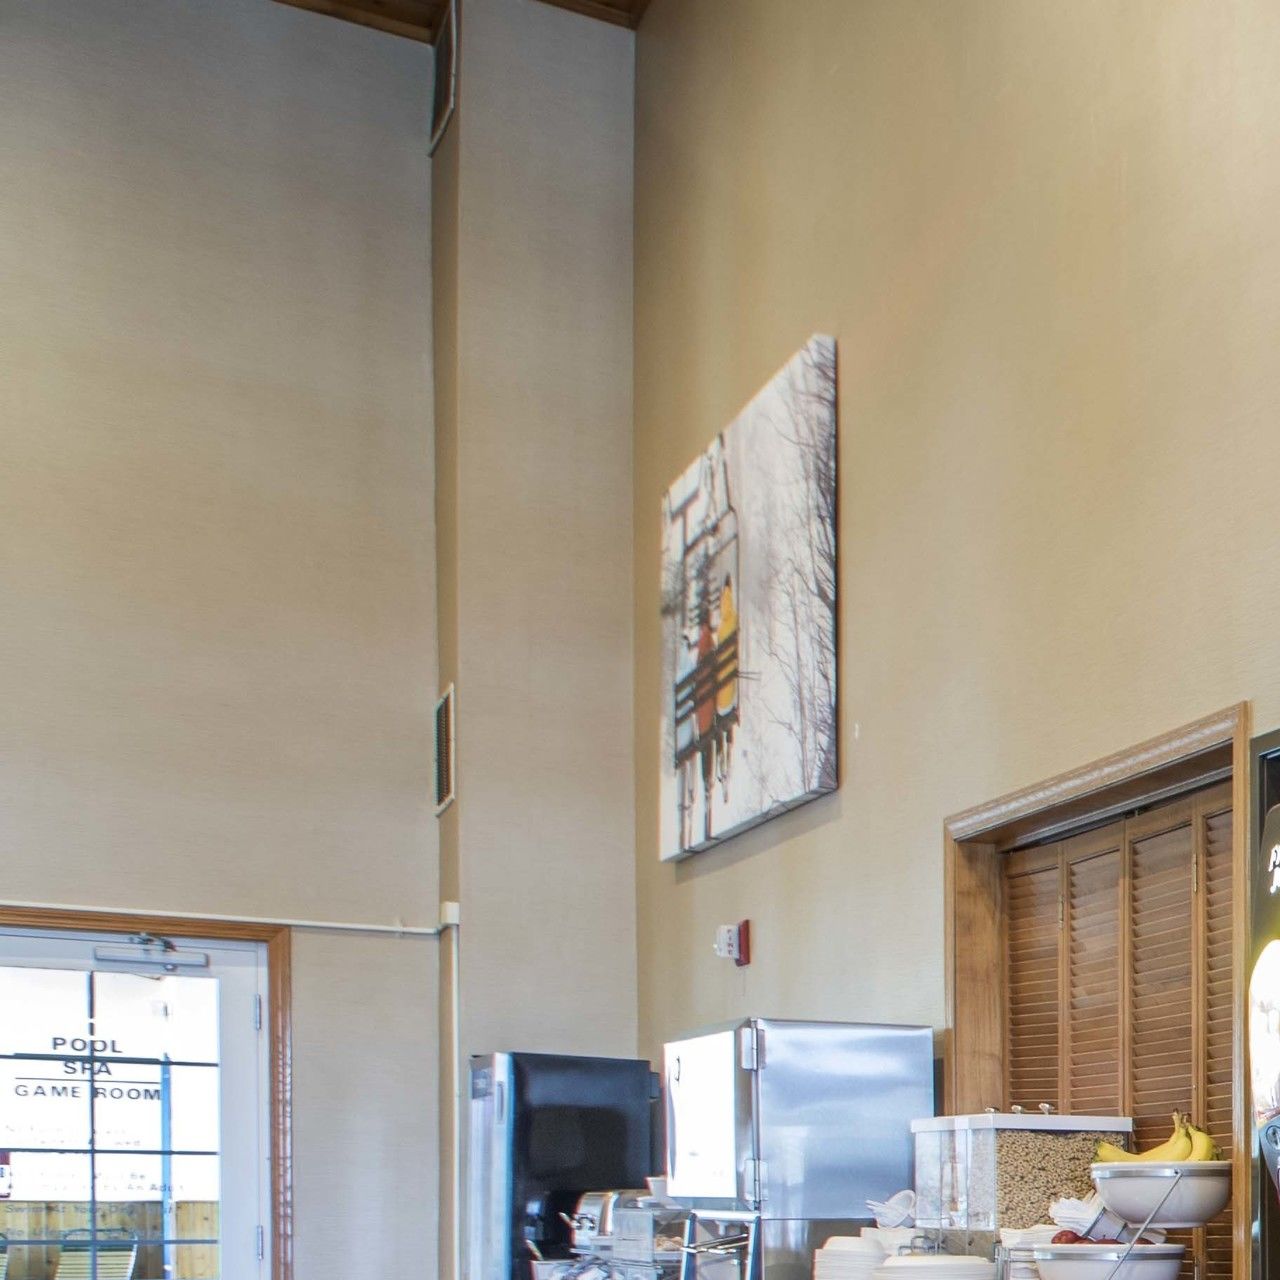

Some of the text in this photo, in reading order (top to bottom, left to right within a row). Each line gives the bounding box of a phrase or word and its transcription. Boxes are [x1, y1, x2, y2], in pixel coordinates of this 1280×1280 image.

[52, 1037, 122, 1053] POOL
[64, 1061, 112, 1076] SPA
[15, 1084, 161, 1101] GAME ROOM
